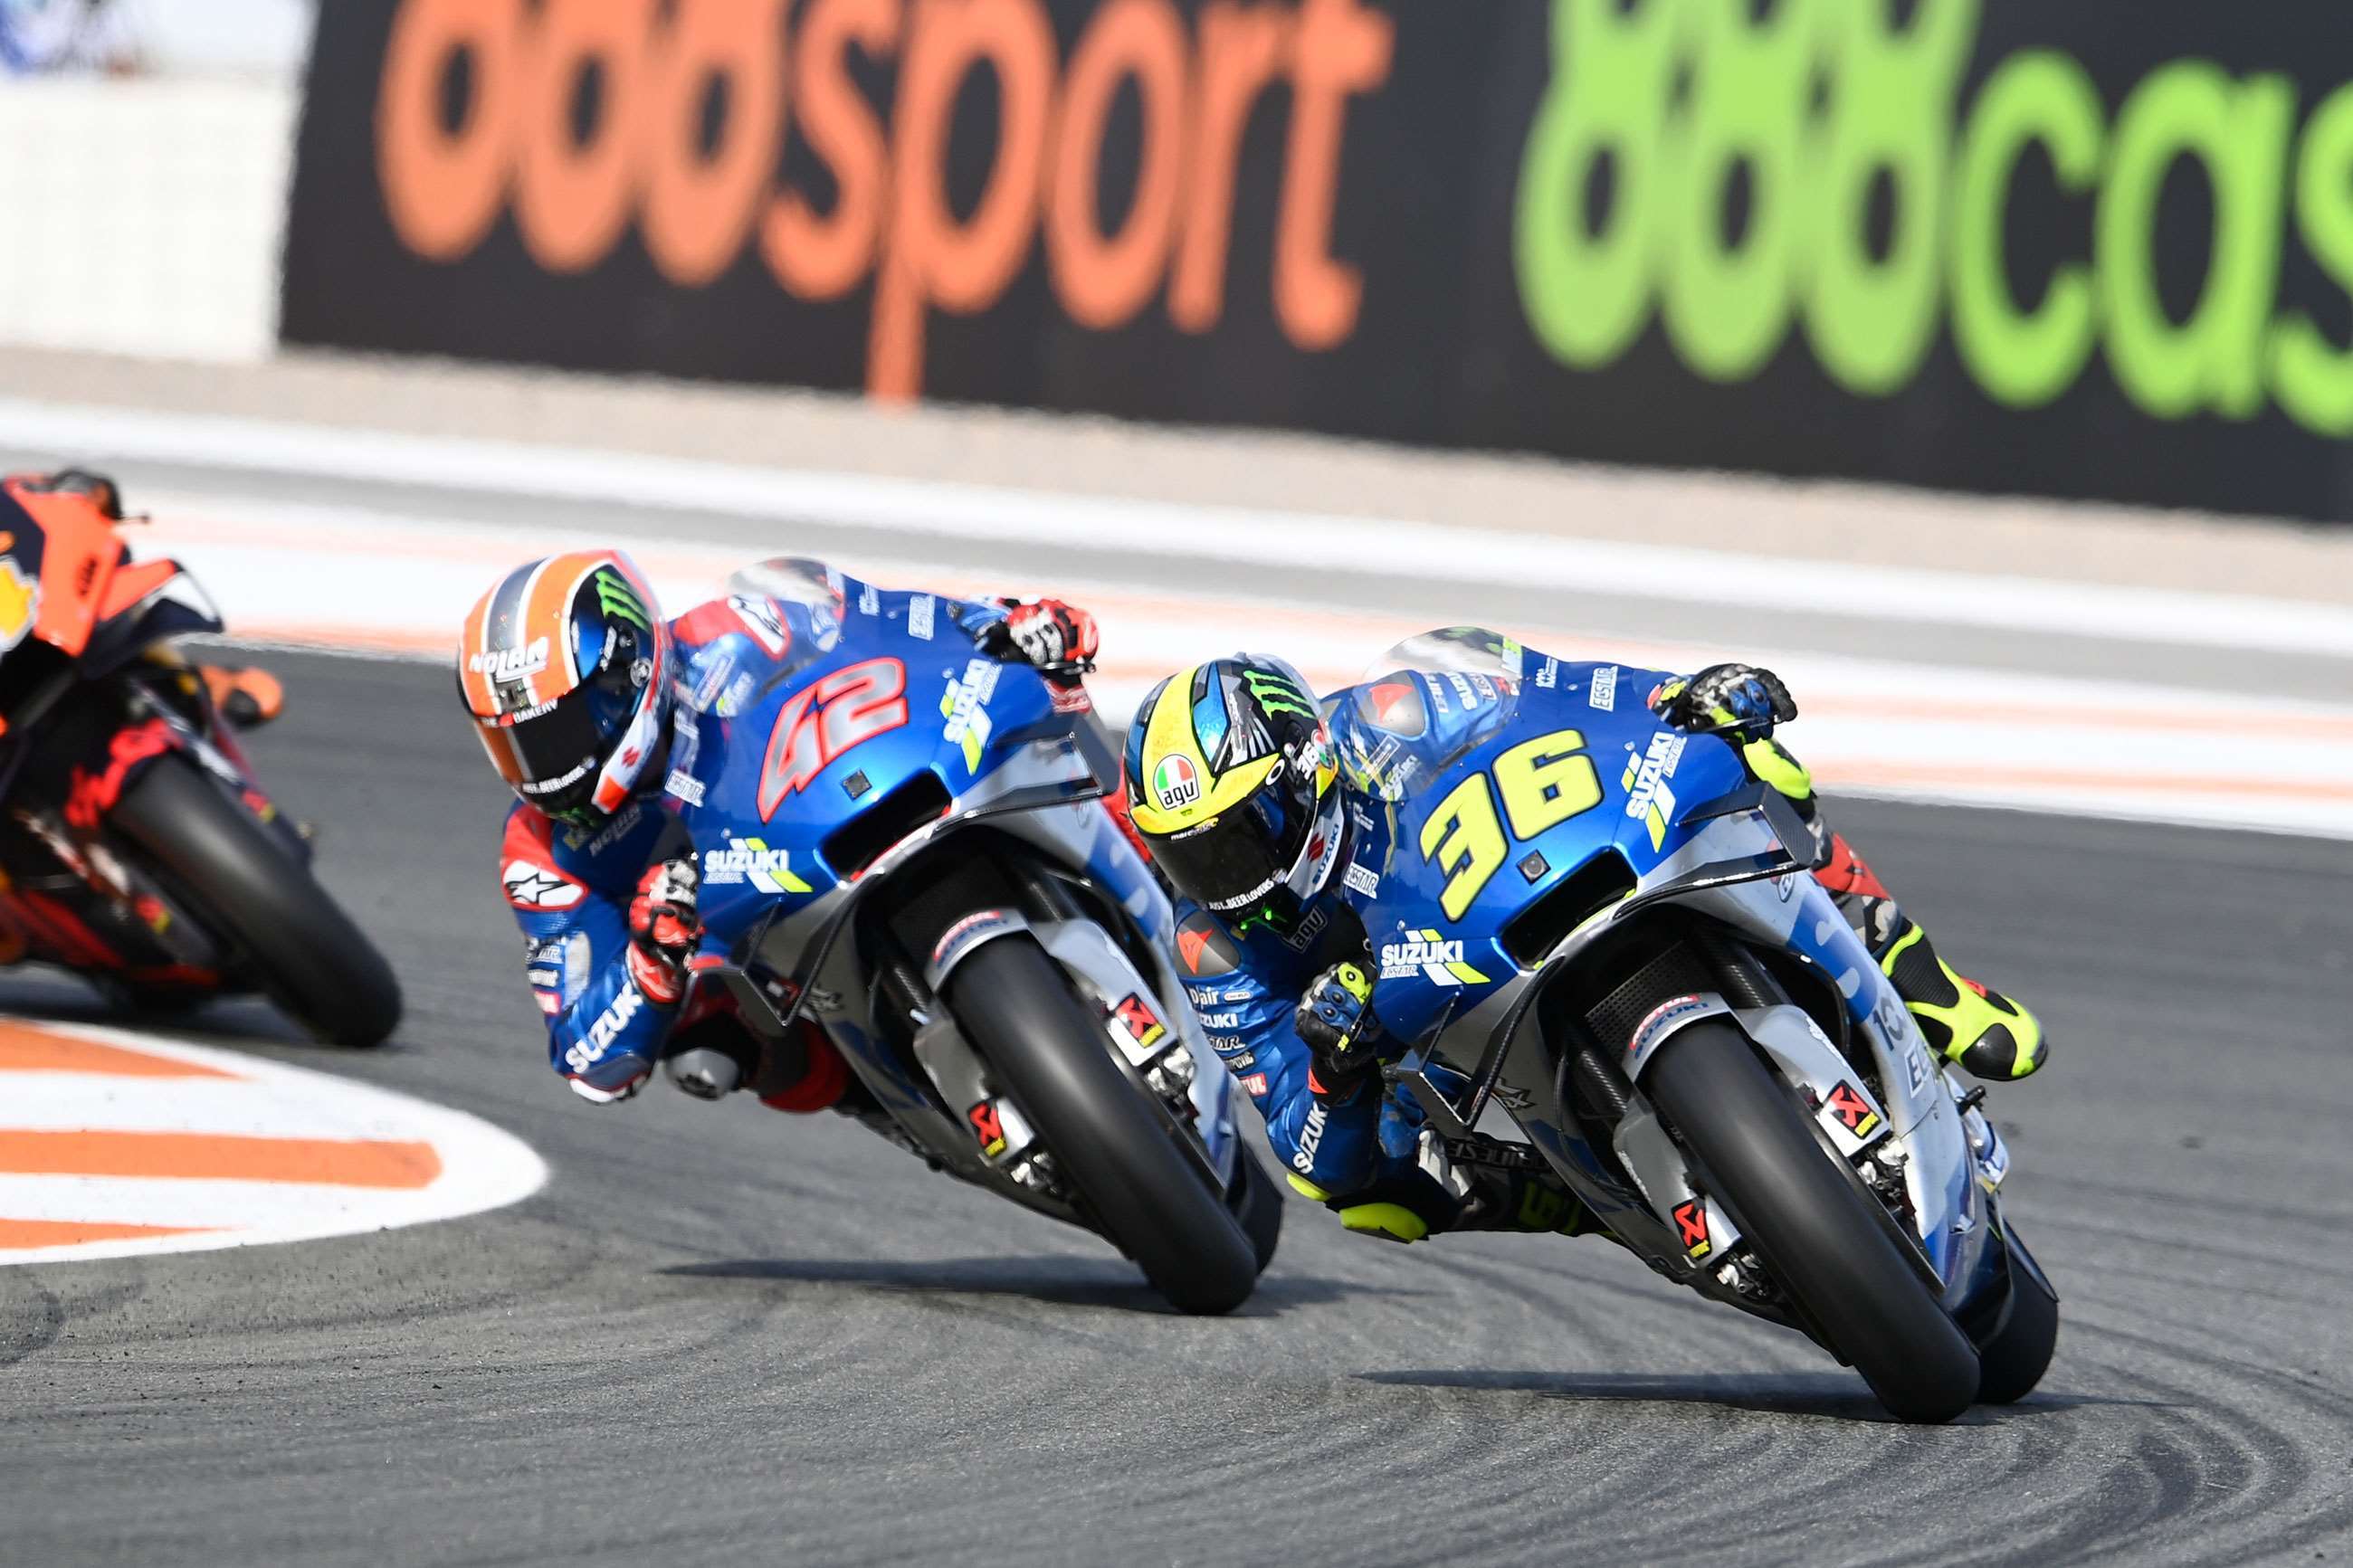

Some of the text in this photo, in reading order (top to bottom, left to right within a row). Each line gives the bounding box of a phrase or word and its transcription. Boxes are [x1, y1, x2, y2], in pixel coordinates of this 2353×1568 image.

[757, 656, 910, 825] 42
[1164, 782, 1195, 805] agv
[1625, 731, 1675, 821] SUZUKI
[1312, 823, 1339, 885] SUZUKI
[1419, 729, 1605, 924] 36
[704, 849, 789, 873] SUZUKI
[1380, 939, 1463, 967] SUZUKI
[565, 980, 644, 1073] SUZUK
[1198, 1012, 1238, 1029] ZUKI
[1634, 1003, 1709, 1060] SUZUKI
